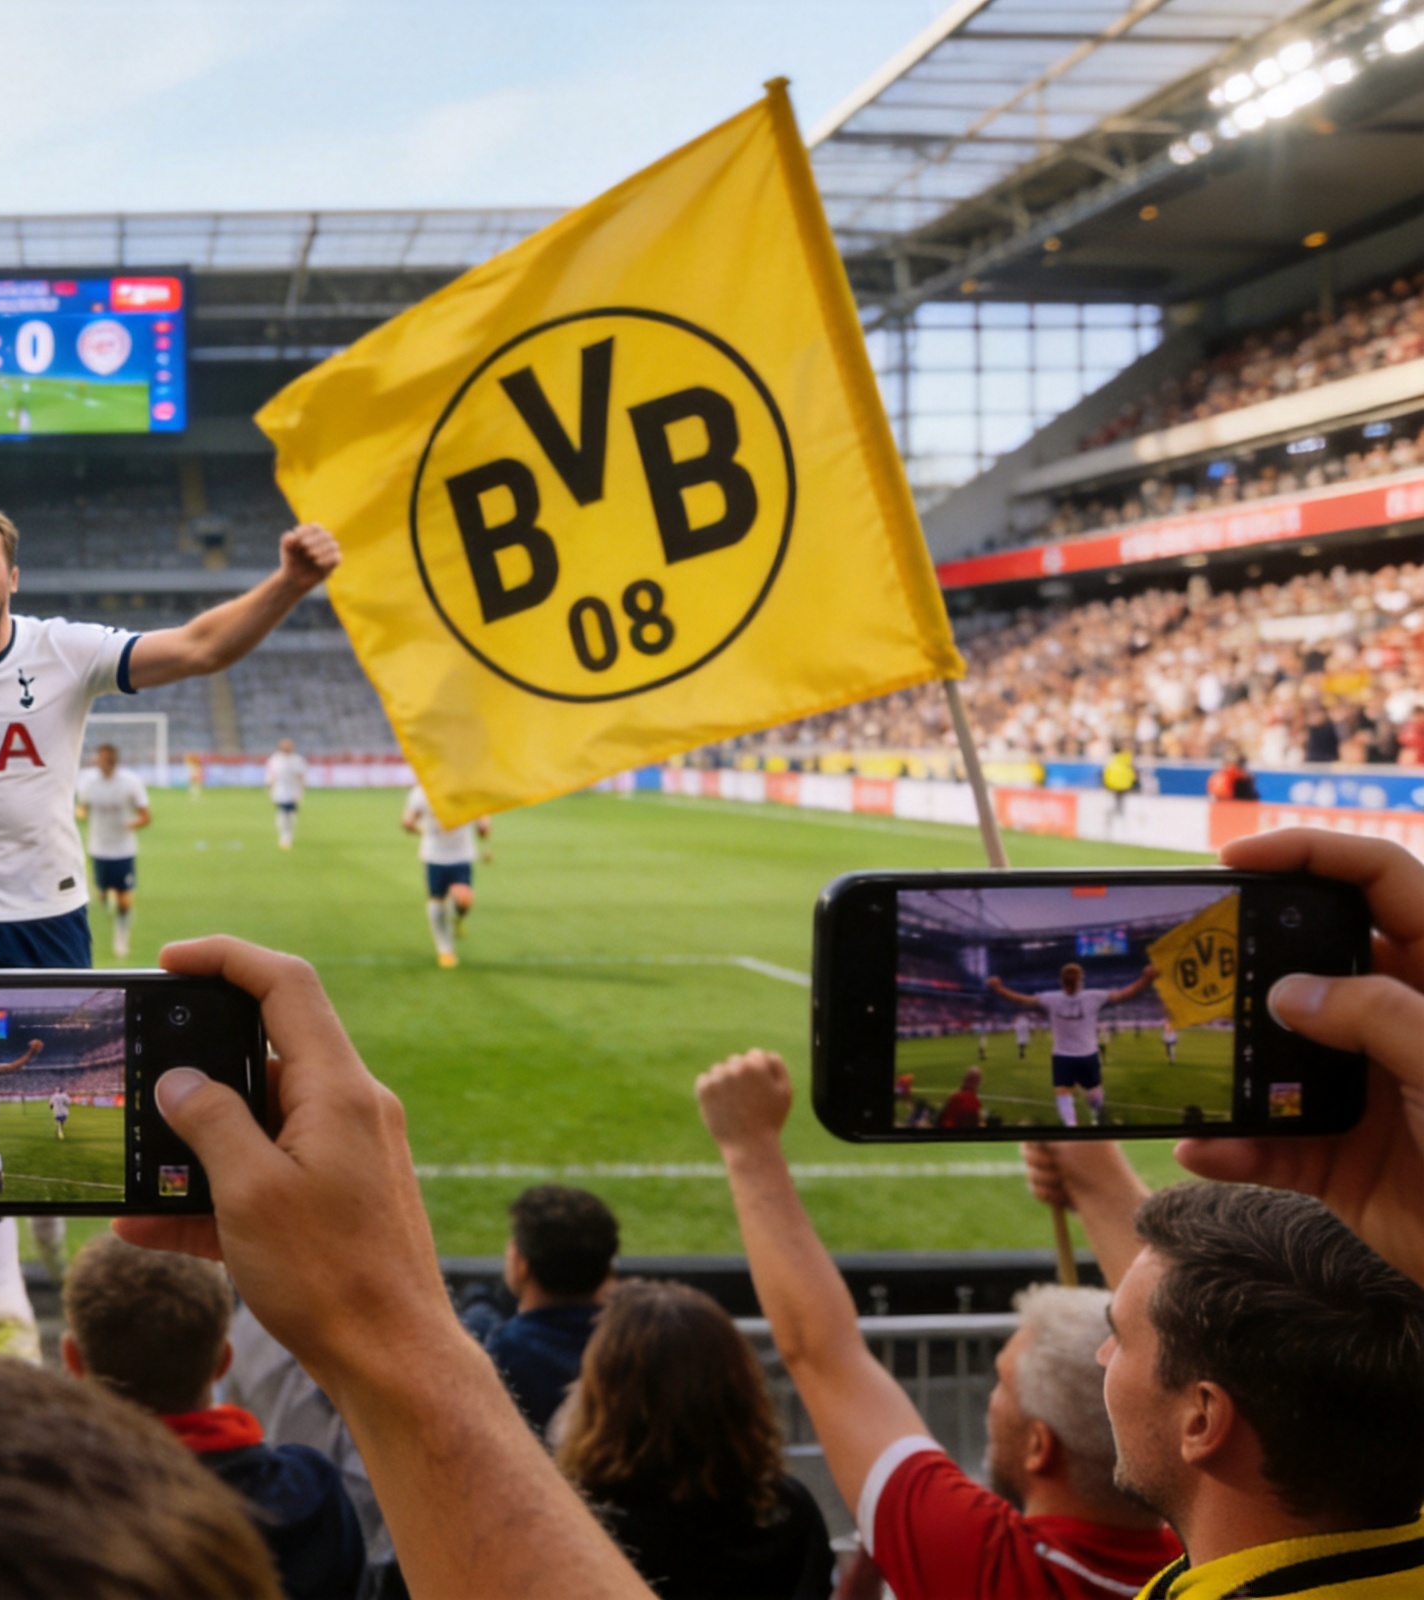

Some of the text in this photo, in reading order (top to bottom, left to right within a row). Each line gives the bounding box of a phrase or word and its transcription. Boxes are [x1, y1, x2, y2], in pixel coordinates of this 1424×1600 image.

[445, 336, 758, 624] BVB
[568, 579, 675, 672] 08
[1180, 934, 1236, 990] BVB
